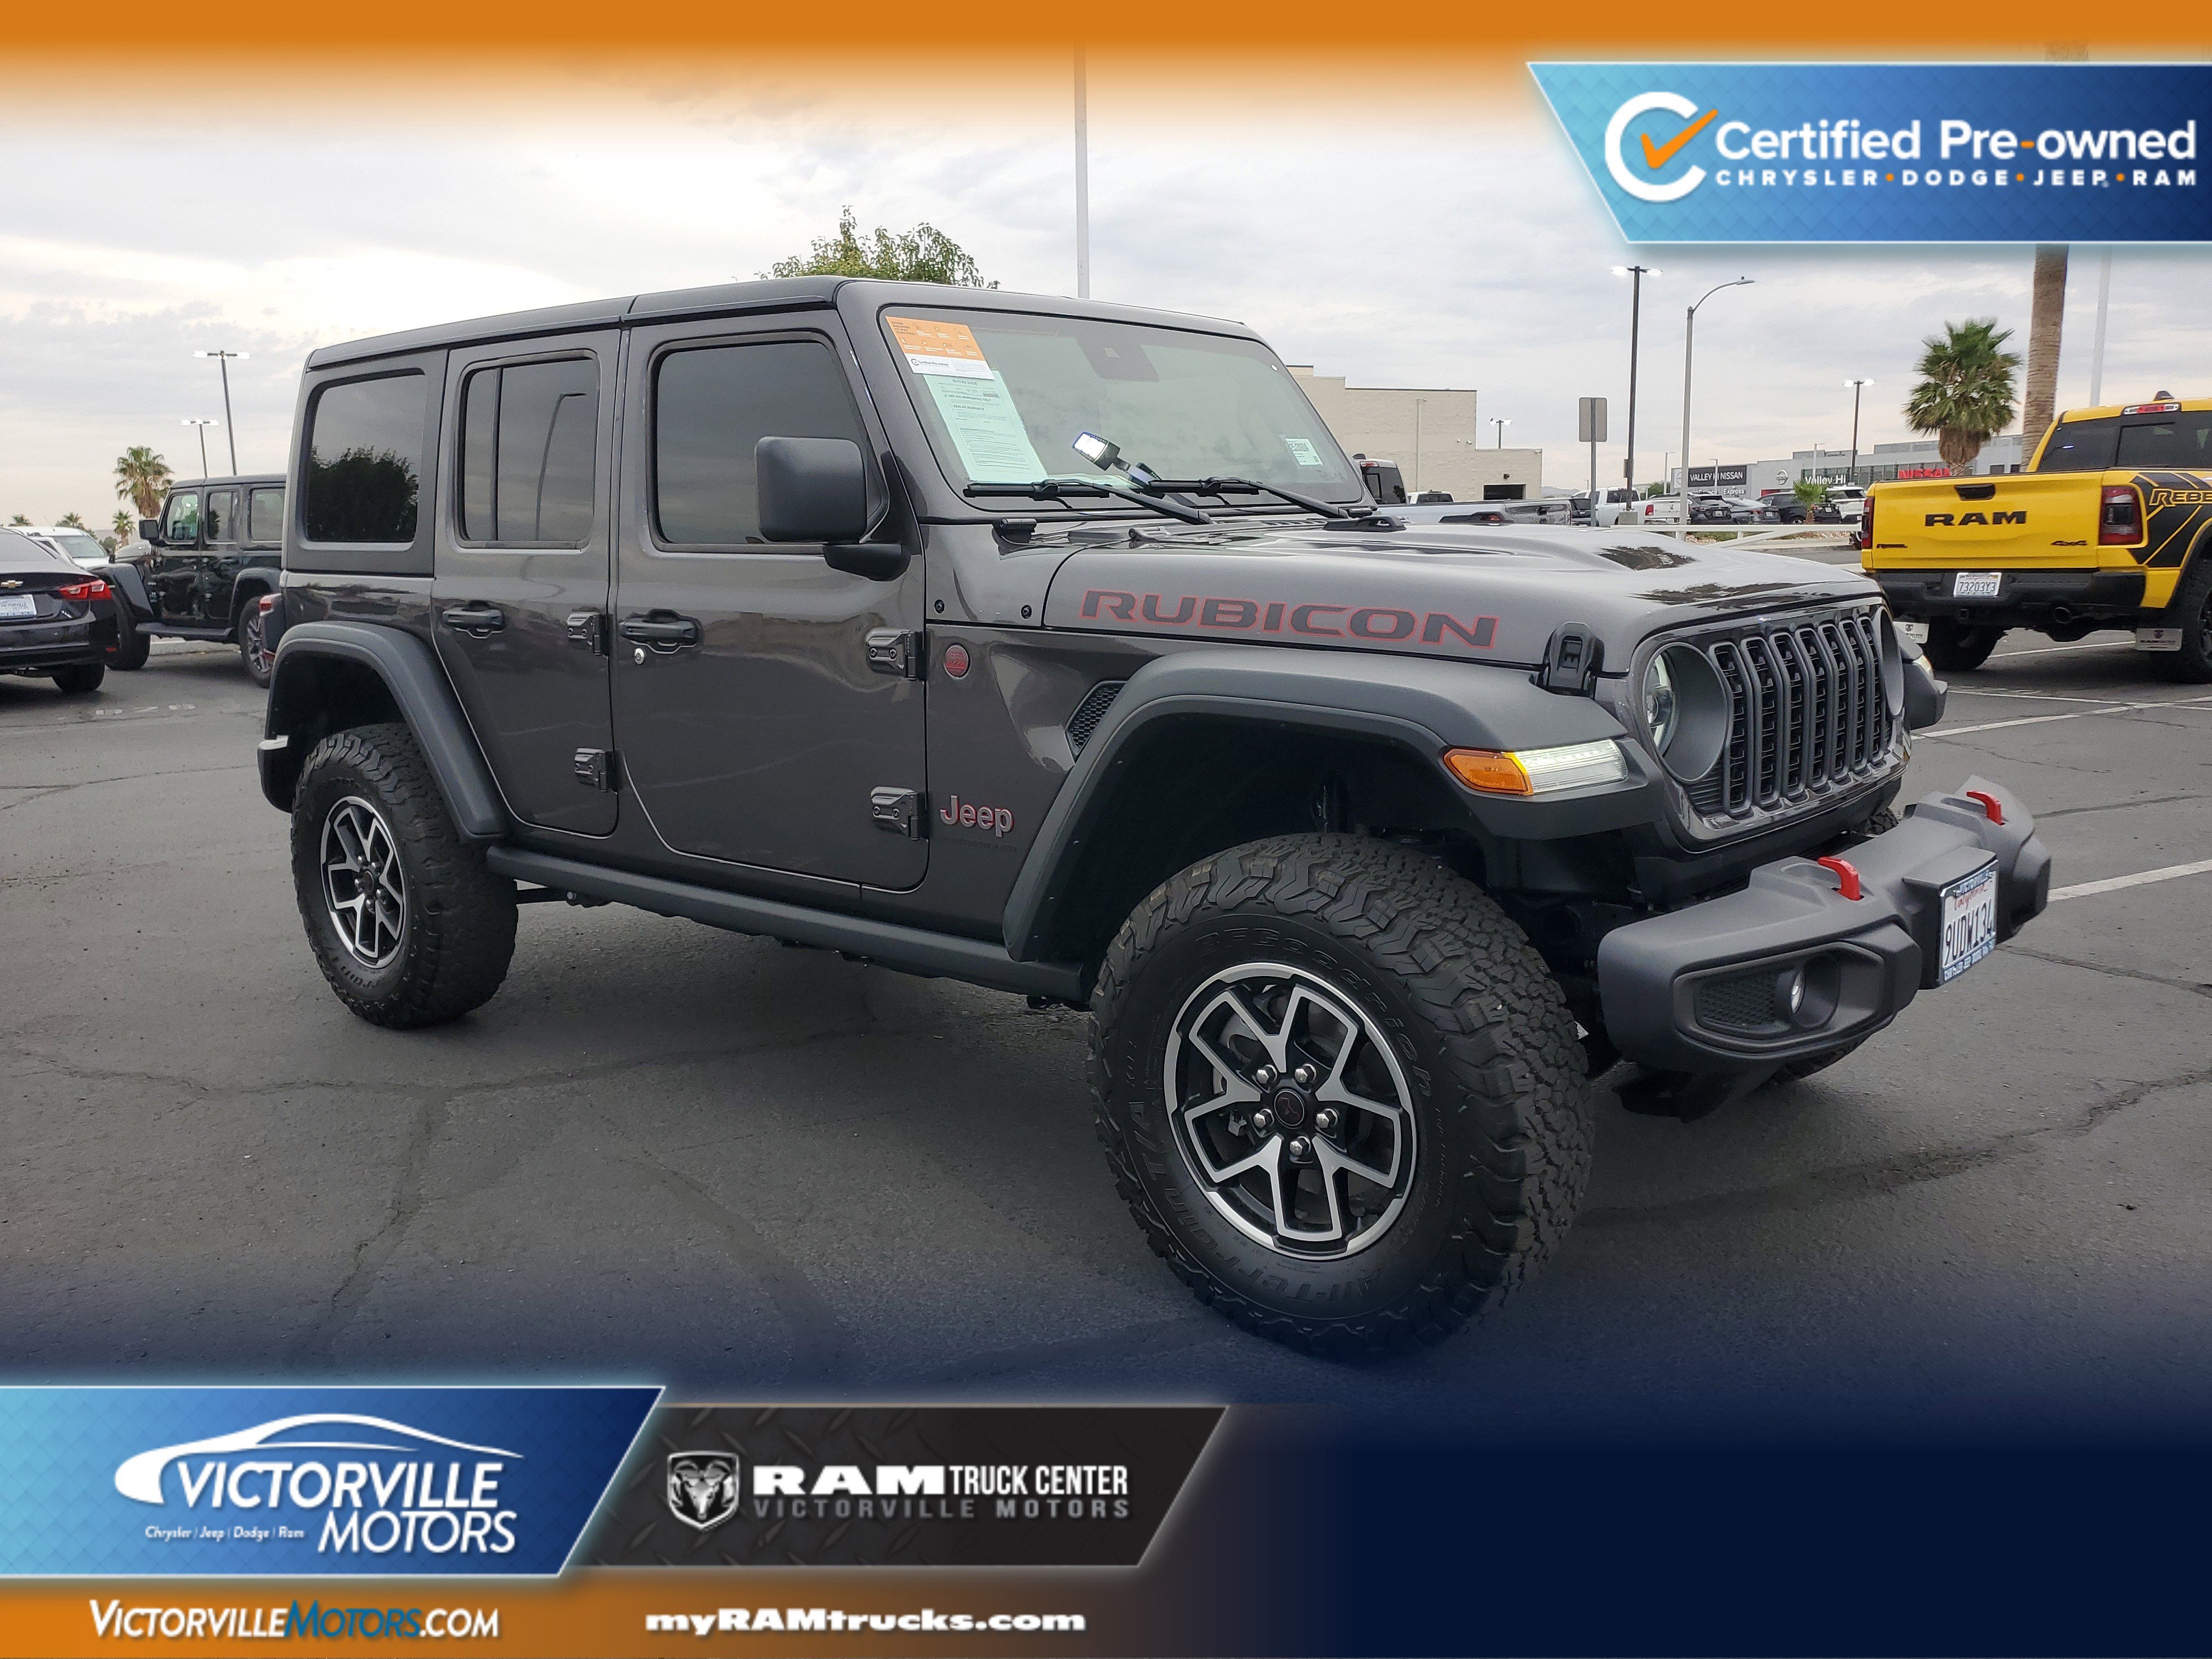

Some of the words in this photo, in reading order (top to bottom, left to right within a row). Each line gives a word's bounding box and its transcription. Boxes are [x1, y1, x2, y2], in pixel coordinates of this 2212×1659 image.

[1690, 472, 1712, 482] VALLEY
[1720, 471, 1743, 480] NISSAN
[1836, 474, 1846, 484] Hi
[1924, 510, 2027, 527] RAM
[1959, 582, 1996, 592] 73203Y3
[1080, 589, 1500, 650] RUBICON
[940, 794, 1014, 838] Jeep
